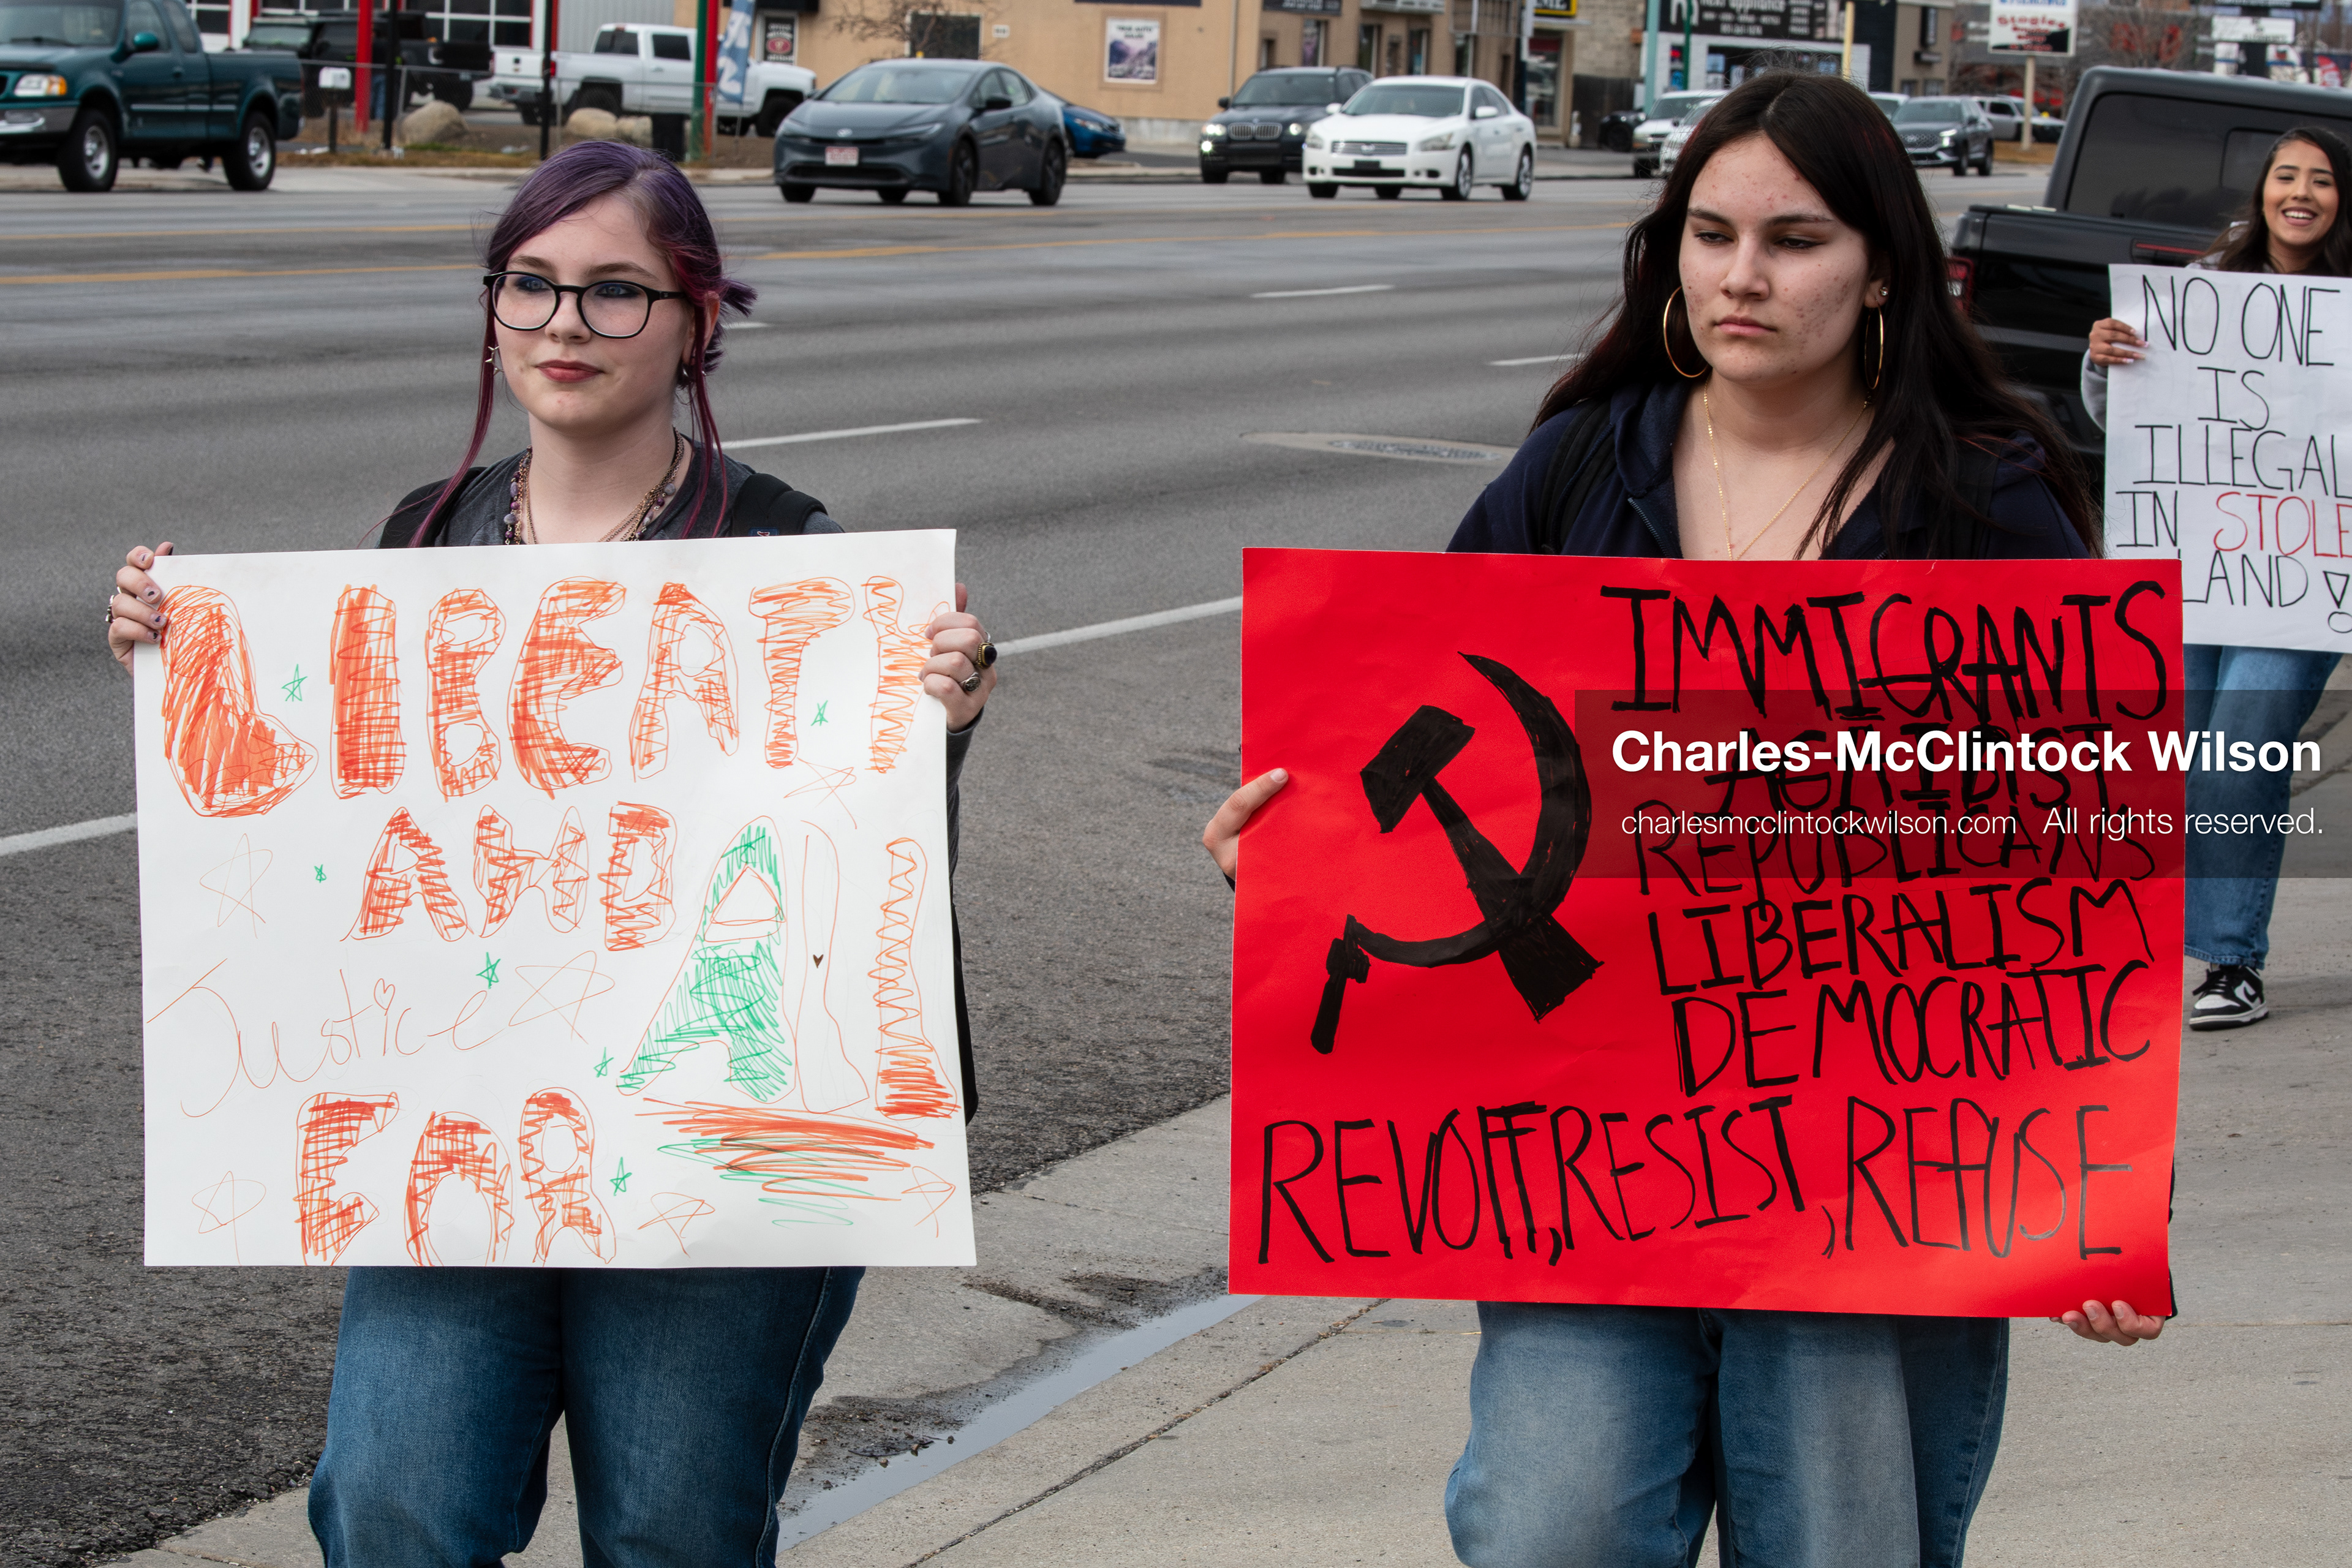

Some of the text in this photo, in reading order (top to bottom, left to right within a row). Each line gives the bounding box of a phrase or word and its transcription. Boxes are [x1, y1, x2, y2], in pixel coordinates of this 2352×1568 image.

[2143, 274, 2341, 367] NO ONE
[2197, 366, 2269, 431] IS
[2115, 490, 2178, 548] IN
[2133, 424, 2352, 497] ILLEGAL
[1600, 580, 2167, 722] IMMIGRANTS
[1648, 877, 2155, 995] LIBERALISM
[146, 958, 505, 1117] Justice
[1672, 960, 2150, 1096] DEMOCRATIC
[1844, 1096, 2133, 1260] REFUSE
